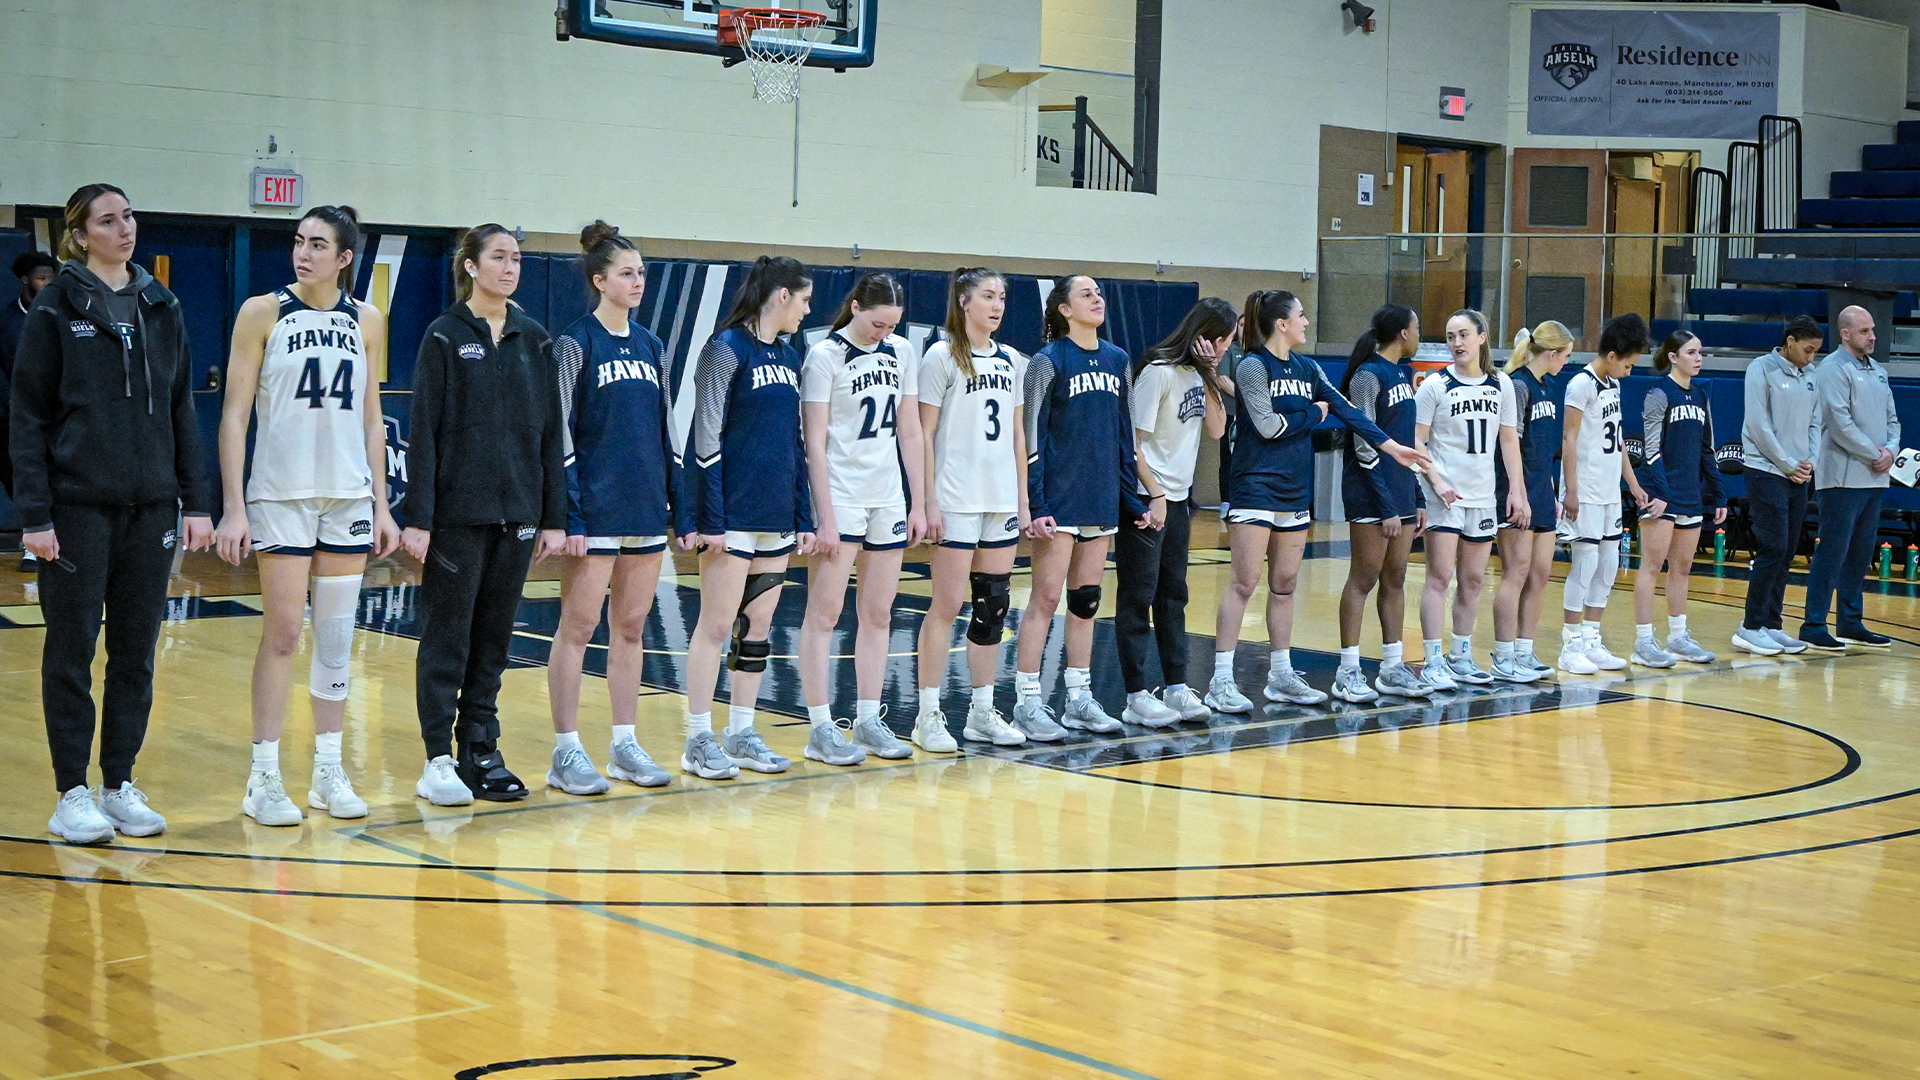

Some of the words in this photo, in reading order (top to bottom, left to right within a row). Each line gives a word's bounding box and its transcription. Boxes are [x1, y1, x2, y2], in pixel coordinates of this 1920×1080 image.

[1545, 52, 1596, 68] ANSELM
[1553, 45, 1588, 53] SAINT
[1617, 45, 1739, 67] Residence
[1744, 51, 1771, 67] INN
[1629, 79, 1648, 87] Lake
[1650, 80, 1681, 88] Avenue,
[1684, 81, 1734, 89] Manchester,
[1534, 95, 1567, 103] OFFICIAL
[264, 176, 297, 203] EXIT
[287, 328, 359, 355] HAWKS
[294, 356, 355, 411] 44
[597, 359, 660, 389] HAWKS
[752, 364, 799, 394] HAWKS
[851, 370, 899, 395] HAWKS
[965, 373, 1013, 395] HAWKS
[1068, 371, 1121, 399] HAWKS
[1270, 378, 1313, 401] HAWKS
[857, 394, 897, 440] 24
[983, 398, 1001, 441] 3
[1450, 399, 1500, 418] HAWKS
[1601, 401, 1620, 421] HAW
[1669, 404, 1706, 427] HAWKS
[1465, 418, 1488, 455] 11
[1601, 420, 1623, 455] 30
[1626, 444, 1642, 456] SELM
[1894, 456, 1908, 469] G
